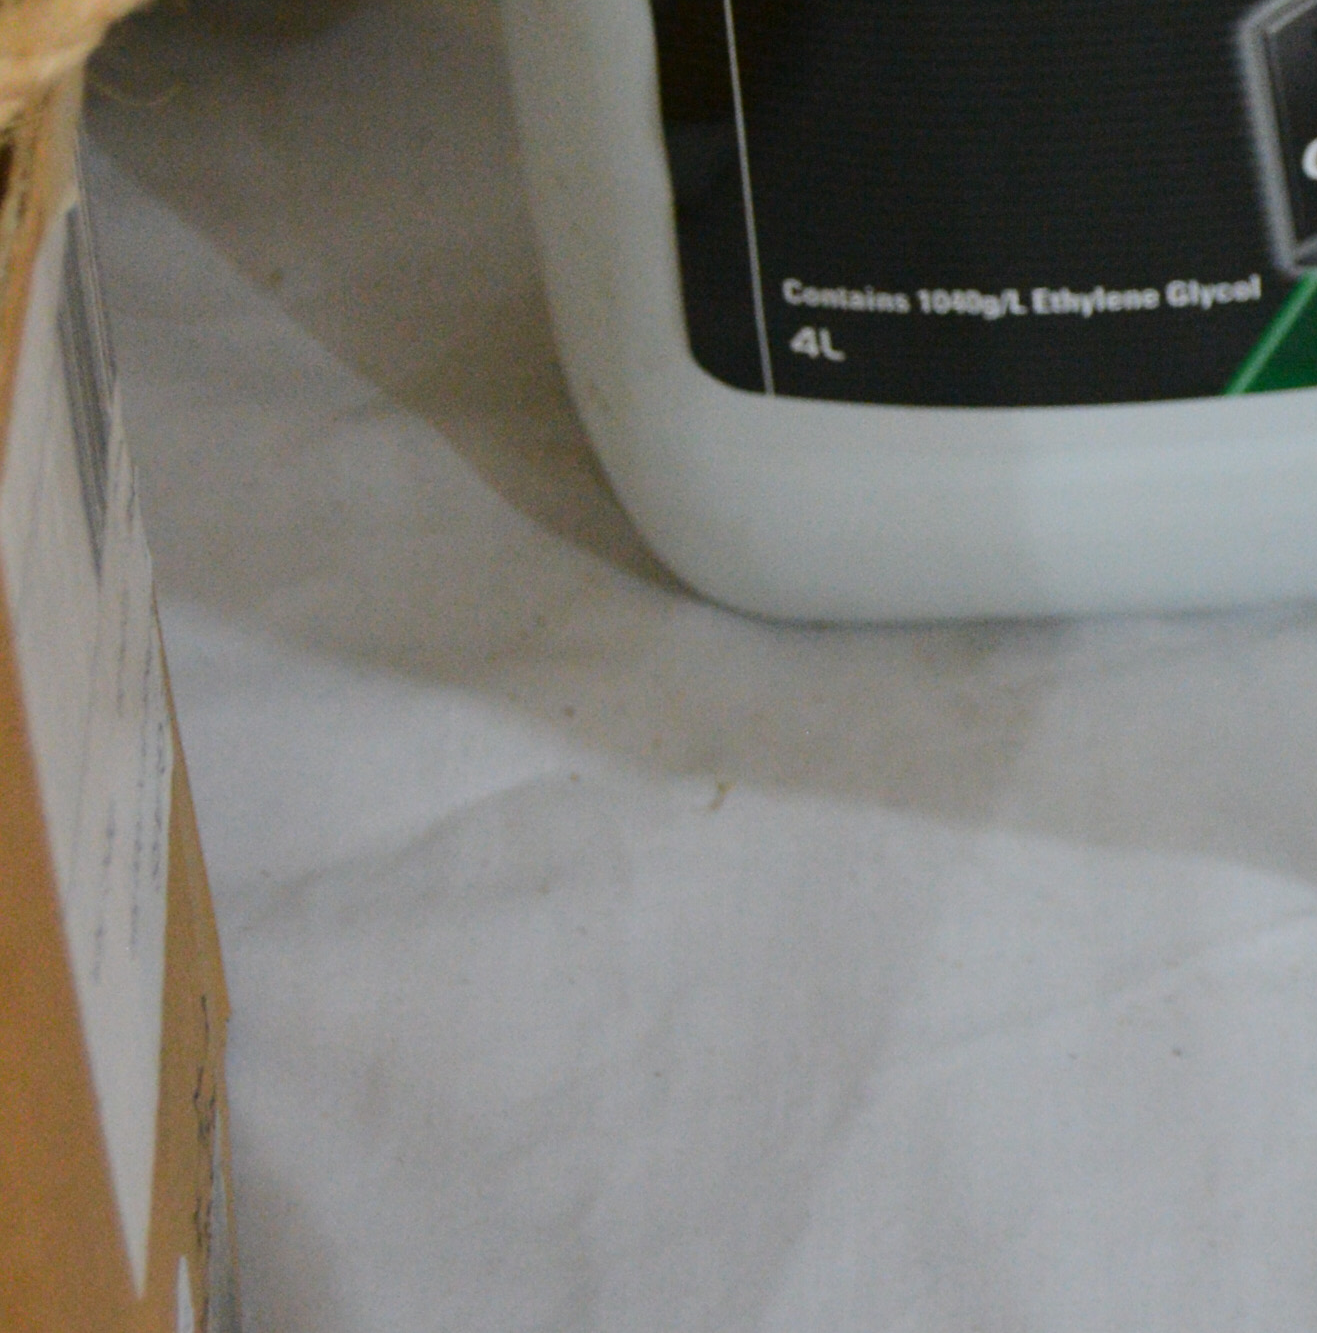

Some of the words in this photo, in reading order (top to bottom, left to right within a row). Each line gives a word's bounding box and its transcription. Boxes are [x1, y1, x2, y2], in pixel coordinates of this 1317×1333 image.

[781, 277, 911, 314] Contains
[1030, 284, 1161, 319] Ethylene
[1164, 272, 1263, 311] Glycol
[788, 325, 847, 362] 4L
